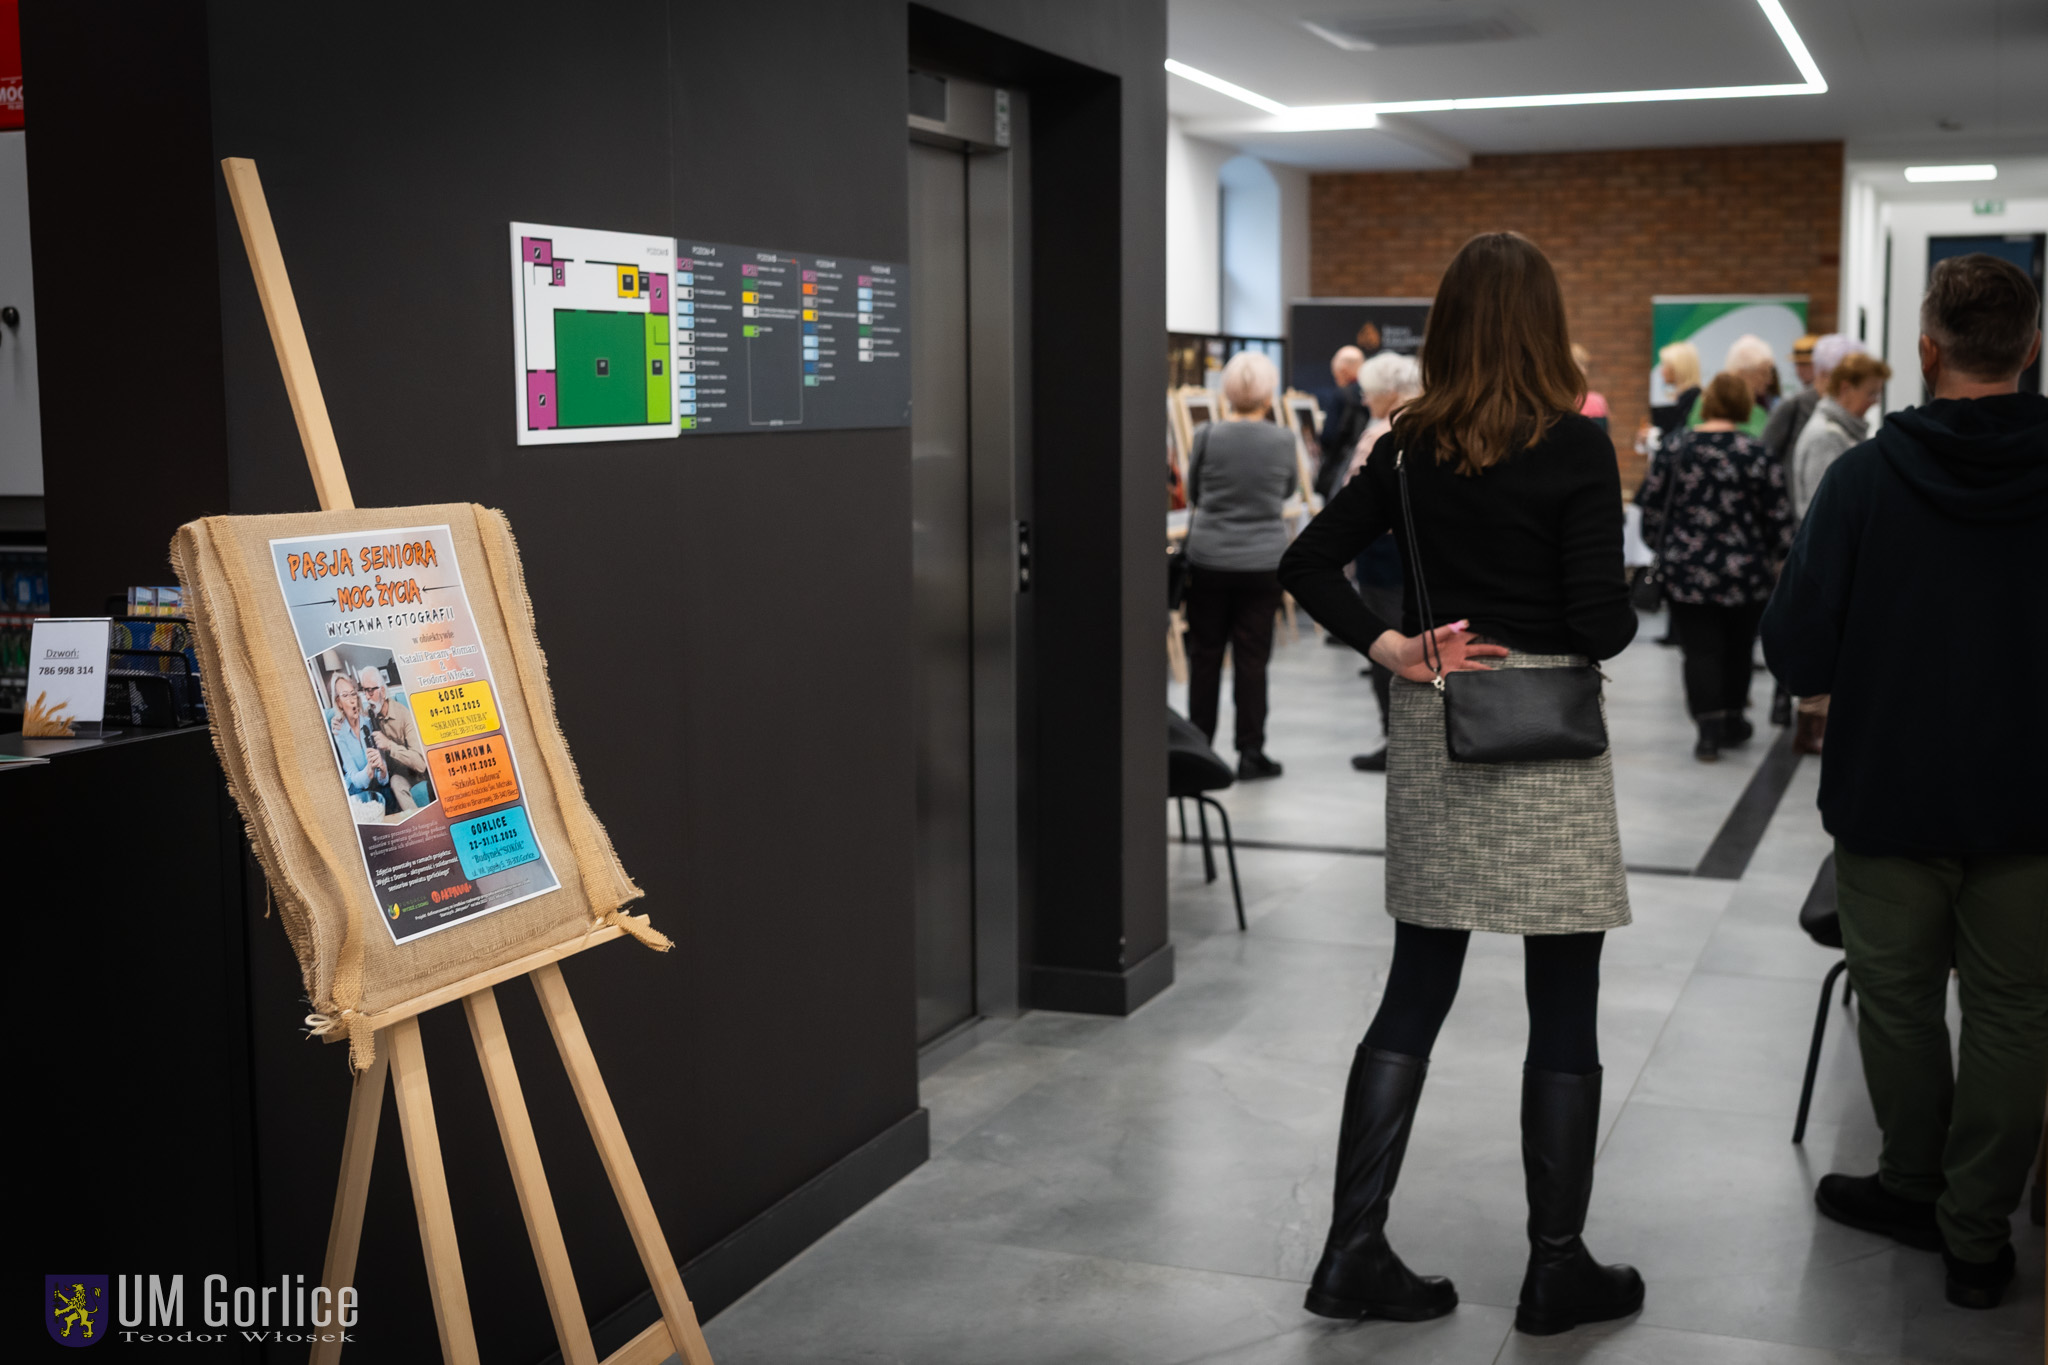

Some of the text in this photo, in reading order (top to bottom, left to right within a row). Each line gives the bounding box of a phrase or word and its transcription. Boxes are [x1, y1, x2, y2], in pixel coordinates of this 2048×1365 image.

[287, 540, 438, 581] PASJA SENIORA
[337, 575, 422, 612] MOC ŻYCIA
[329, 609, 452, 636] WYSTAWA FOTOGRAFII
[420, 630, 454, 643] obiektywie
[46, 648, 80, 659] Dzwoń:
[38, 666, 94, 676] 786 998 314
[417, 668, 474, 686] Teodora Włoska
[439, 688, 464, 702] ŁOSIE
[430, 700, 480, 717] 09-12.12.2025
[445, 744, 492, 763] BINAROWA
[448, 758, 496, 776] 15-19.12.2025
[471, 816, 507, 835] GORLICE
[469, 829, 517, 850] 22-31.12.2025
